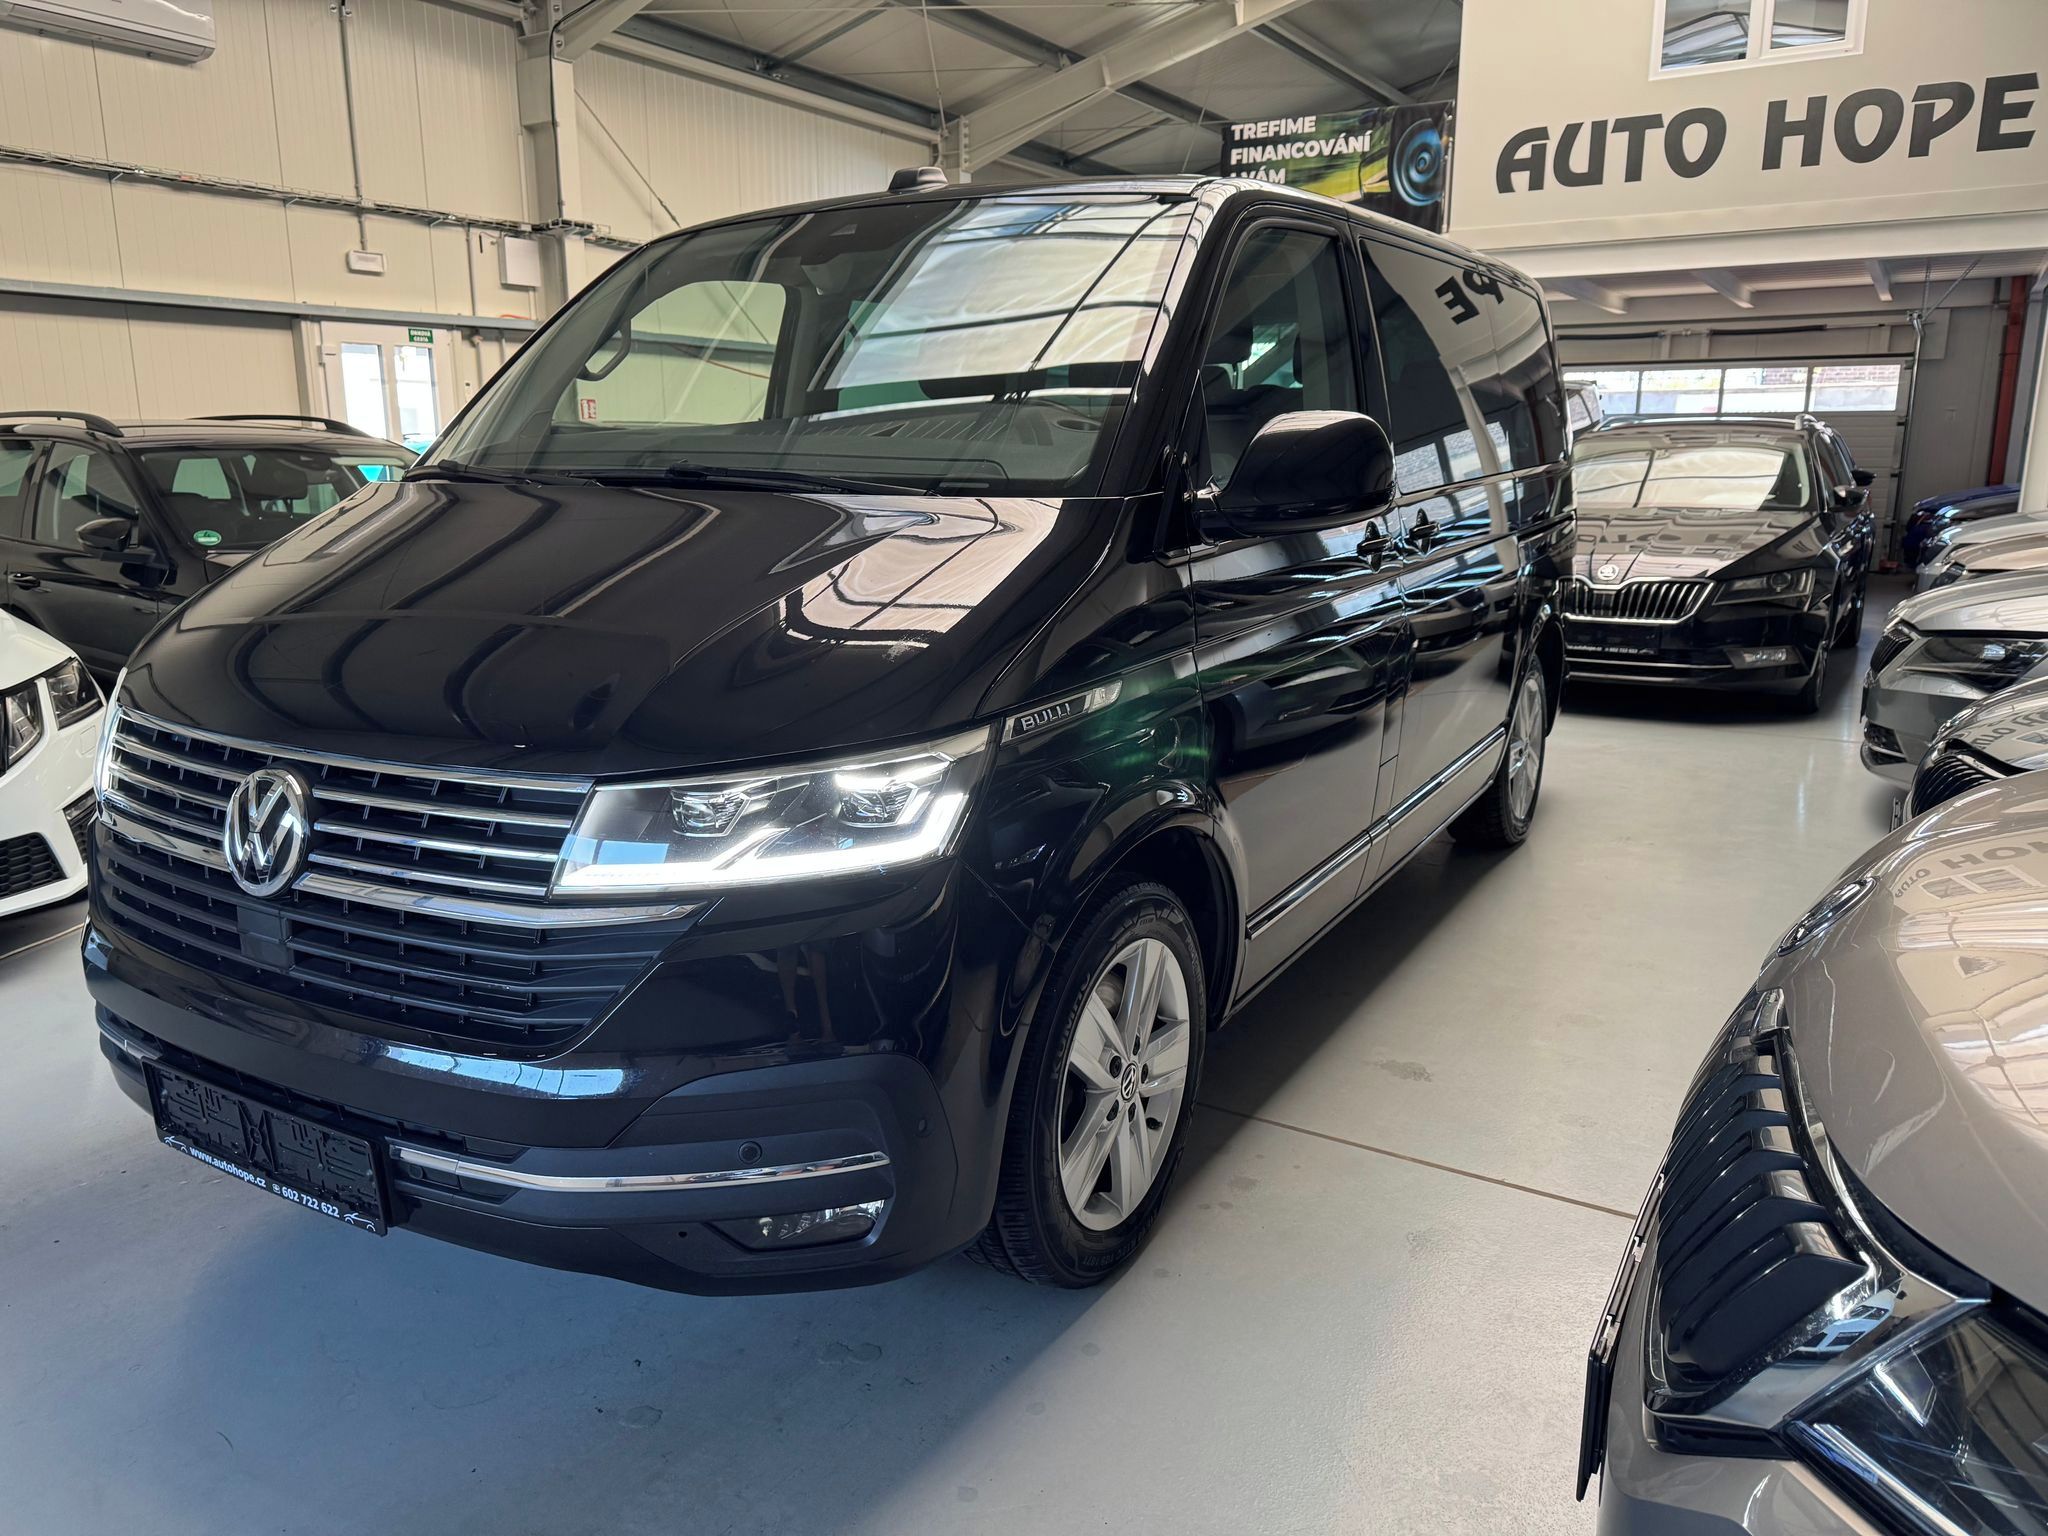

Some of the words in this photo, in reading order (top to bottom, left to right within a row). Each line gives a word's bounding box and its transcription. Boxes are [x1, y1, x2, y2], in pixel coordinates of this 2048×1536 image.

[1230, 115, 1317, 141] TREFIME
[1496, 107, 1727, 194] AUTO
[1762, 72, 2040, 170] HOPE
[1230, 130, 1373, 166] FINANCOVÁNÍ
[1021, 703, 1071, 731] BULLI
[189, 1146, 266, 1188] www.autohope.cz
[282, 1186, 299, 1202] 602
[301, 1193, 319, 1210] 722
[321, 1201, 340, 1218] 622
